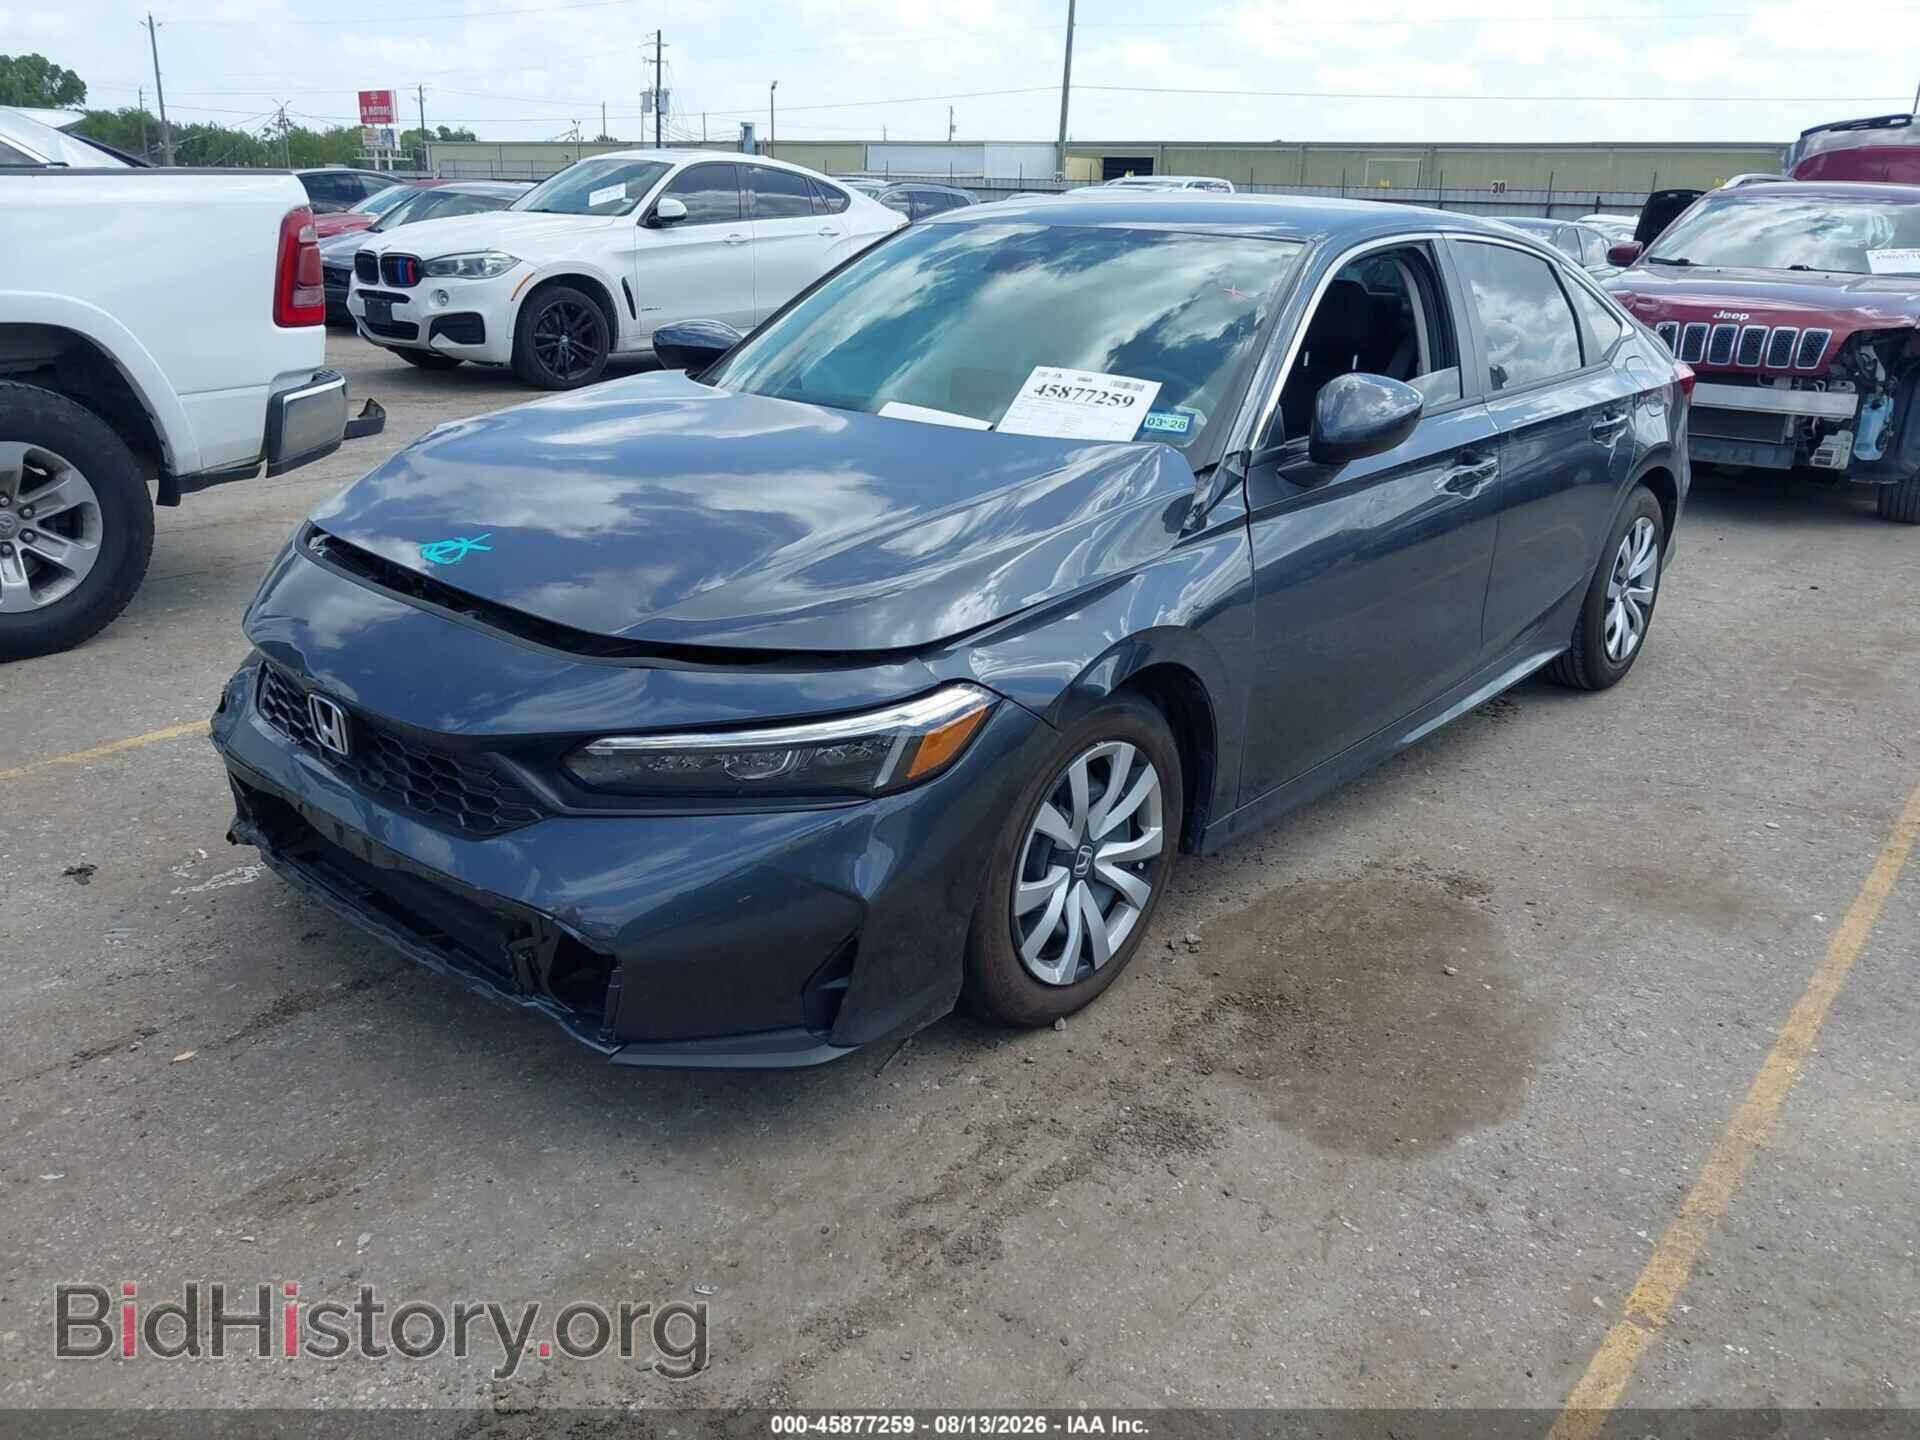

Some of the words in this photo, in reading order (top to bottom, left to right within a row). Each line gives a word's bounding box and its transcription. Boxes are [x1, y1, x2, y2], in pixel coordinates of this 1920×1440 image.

[1491, 181, 1506, 194] 30
[1712, 310, 1750, 321] Jeep
[1033, 383, 1136, 409] 45877259
[1147, 417, 1163, 427] 03
[1169, 420, 1186, 429] 28
